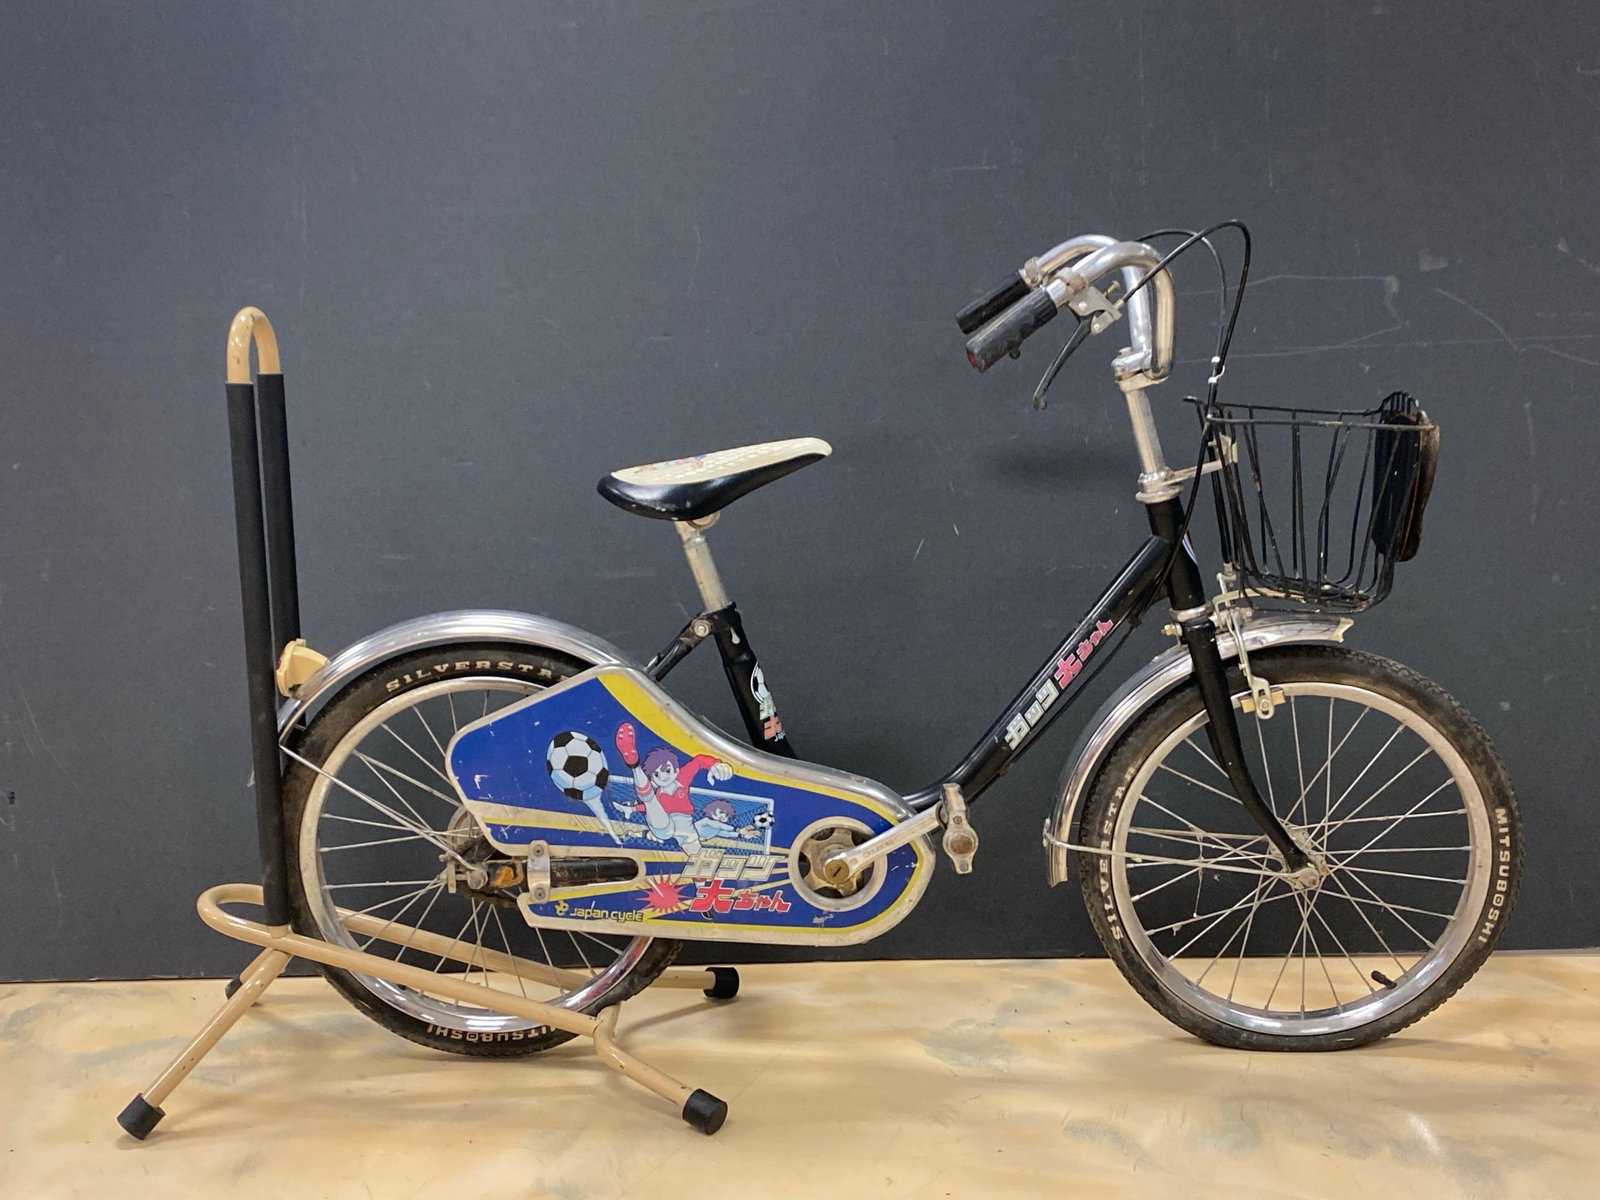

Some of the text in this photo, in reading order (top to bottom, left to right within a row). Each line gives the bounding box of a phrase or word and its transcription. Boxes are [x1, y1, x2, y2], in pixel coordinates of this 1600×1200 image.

[1478, 808, 1511, 943] MITSUBOSHI
[689, 878, 792, 914] 大ちゃん
[610, 910, 644, 923] cycle
